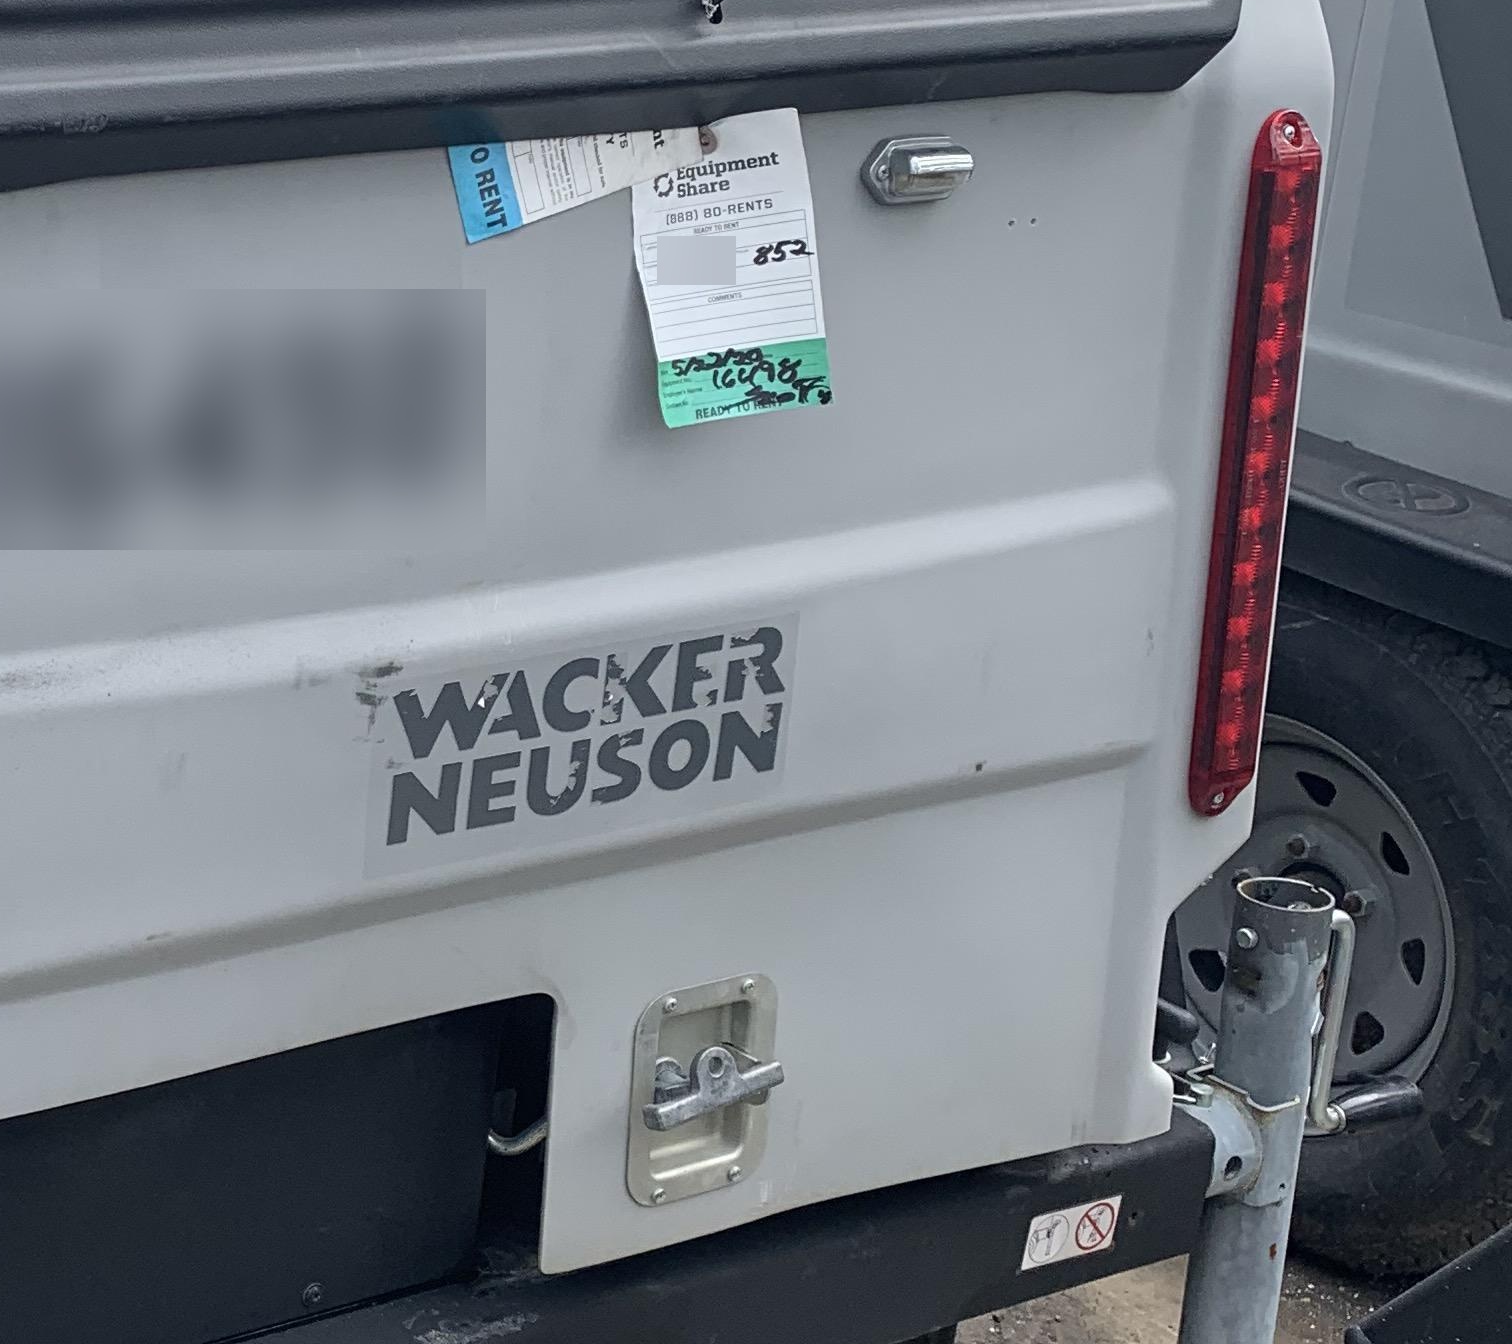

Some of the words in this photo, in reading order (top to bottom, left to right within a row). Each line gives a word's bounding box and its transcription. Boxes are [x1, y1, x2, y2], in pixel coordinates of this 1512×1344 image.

[676, 151, 780, 181] Equipment
[475, 167, 508, 229] RENT
[676, 179, 731, 199] Share
[666, 210, 699, 225] (888)
[693, 225, 713, 234] READY
[723, 222, 740, 230] RENT
[753, 239, 815, 266] 852
[707, 292, 743, 303] COMMENTS
[695, 404, 731, 420] READY
[392, 626, 786, 759] WACKER
[386, 702, 783, 846] NEUSON
